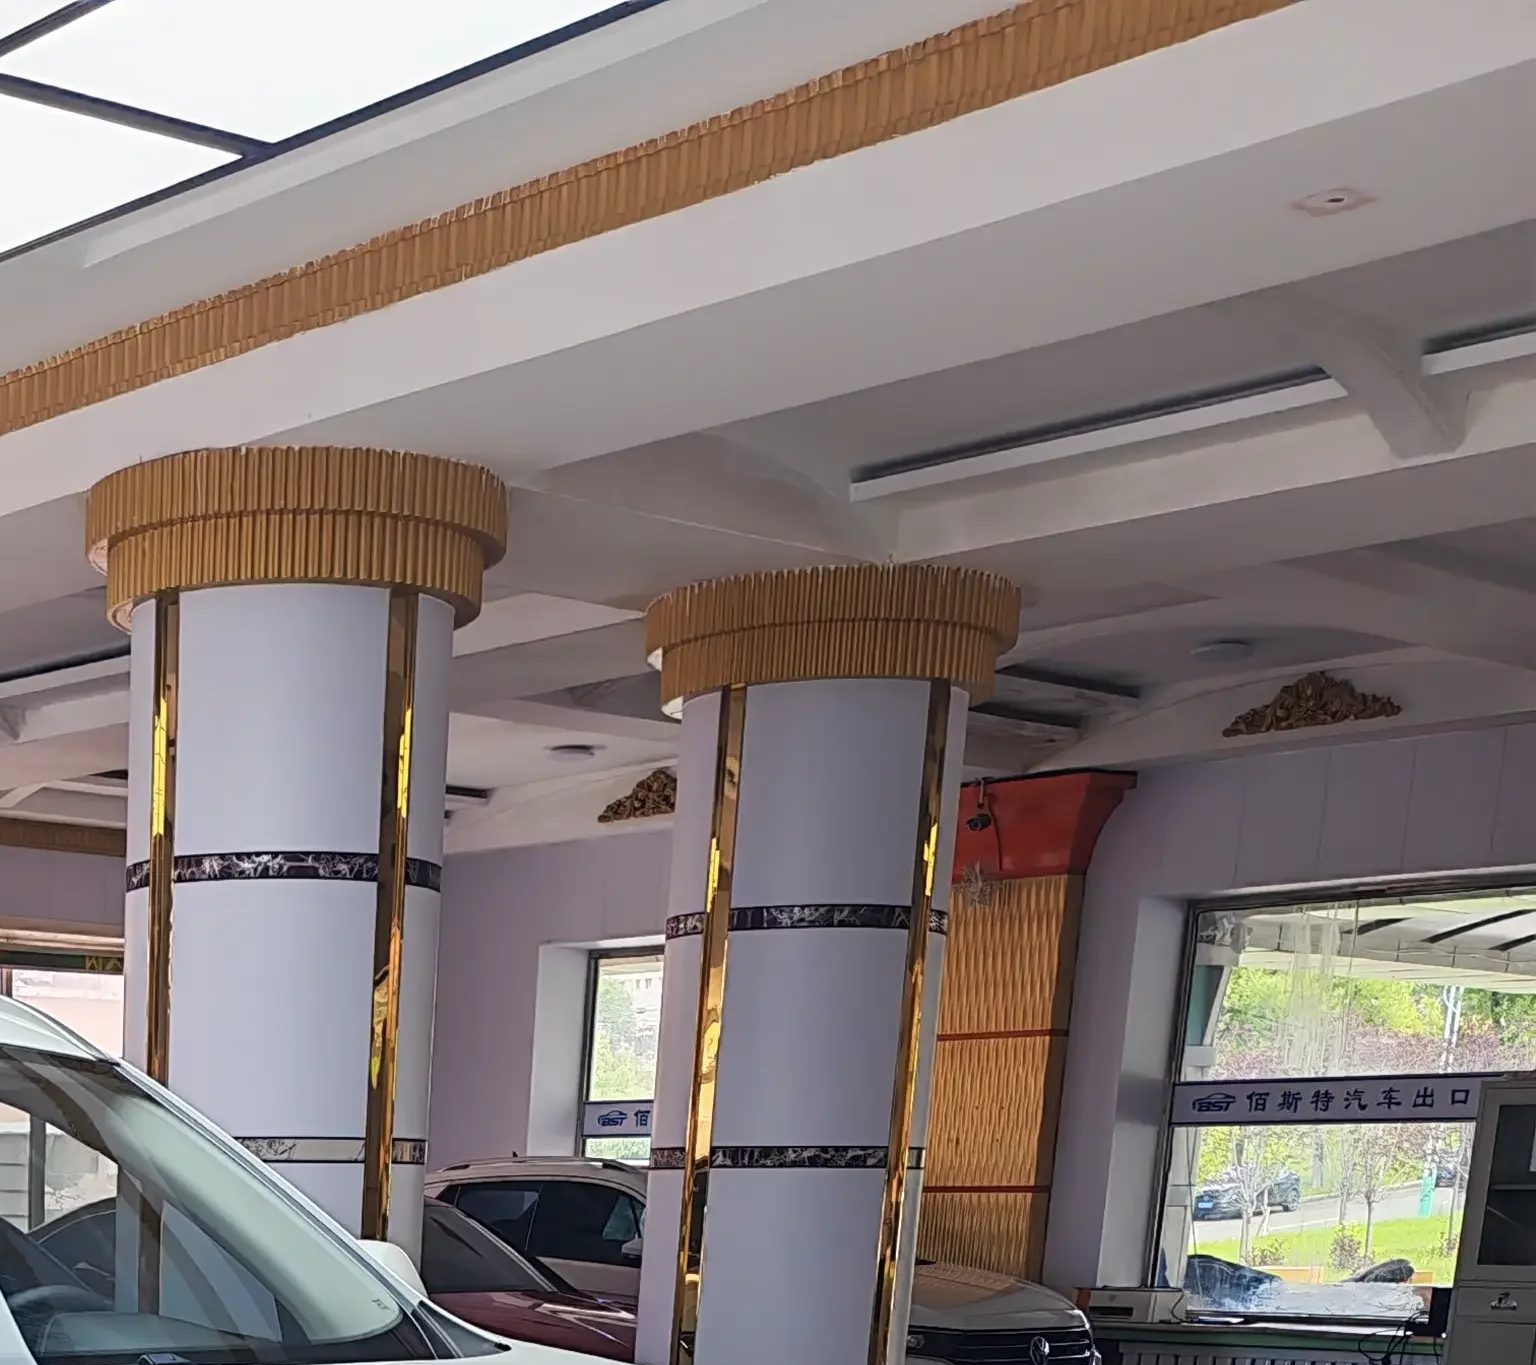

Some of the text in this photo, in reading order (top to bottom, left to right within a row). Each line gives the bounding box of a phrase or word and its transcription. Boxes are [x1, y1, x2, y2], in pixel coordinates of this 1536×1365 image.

[1246, 1086, 1471, 1113] 佰斯特汽车出口
